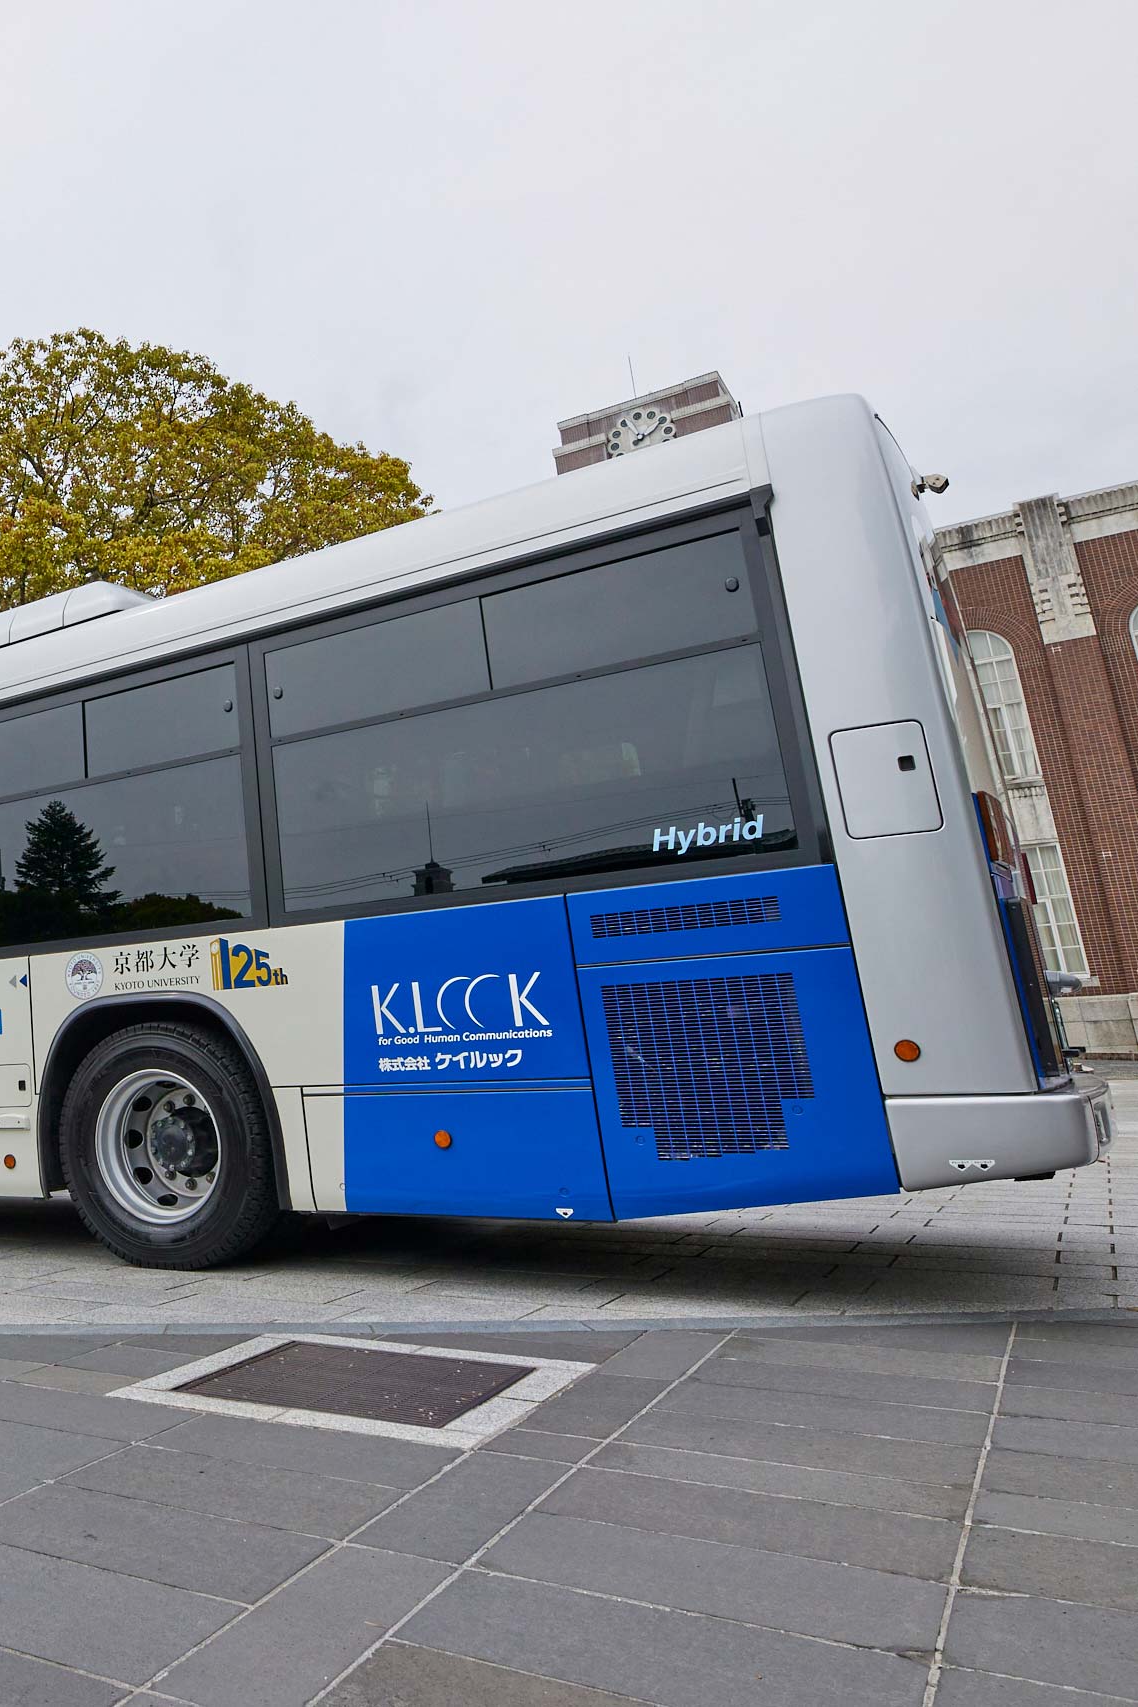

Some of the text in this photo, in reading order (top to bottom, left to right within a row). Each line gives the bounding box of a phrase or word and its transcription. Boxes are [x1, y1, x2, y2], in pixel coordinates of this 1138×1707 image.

[112, 944, 200, 975] 京都大学
[114, 975, 201, 991] KYOTO UNIVERSITY
[378, 1028, 553, 1046] for Good Human Communications
[378, 1049, 523, 1072] 株式会社 ケイルック
